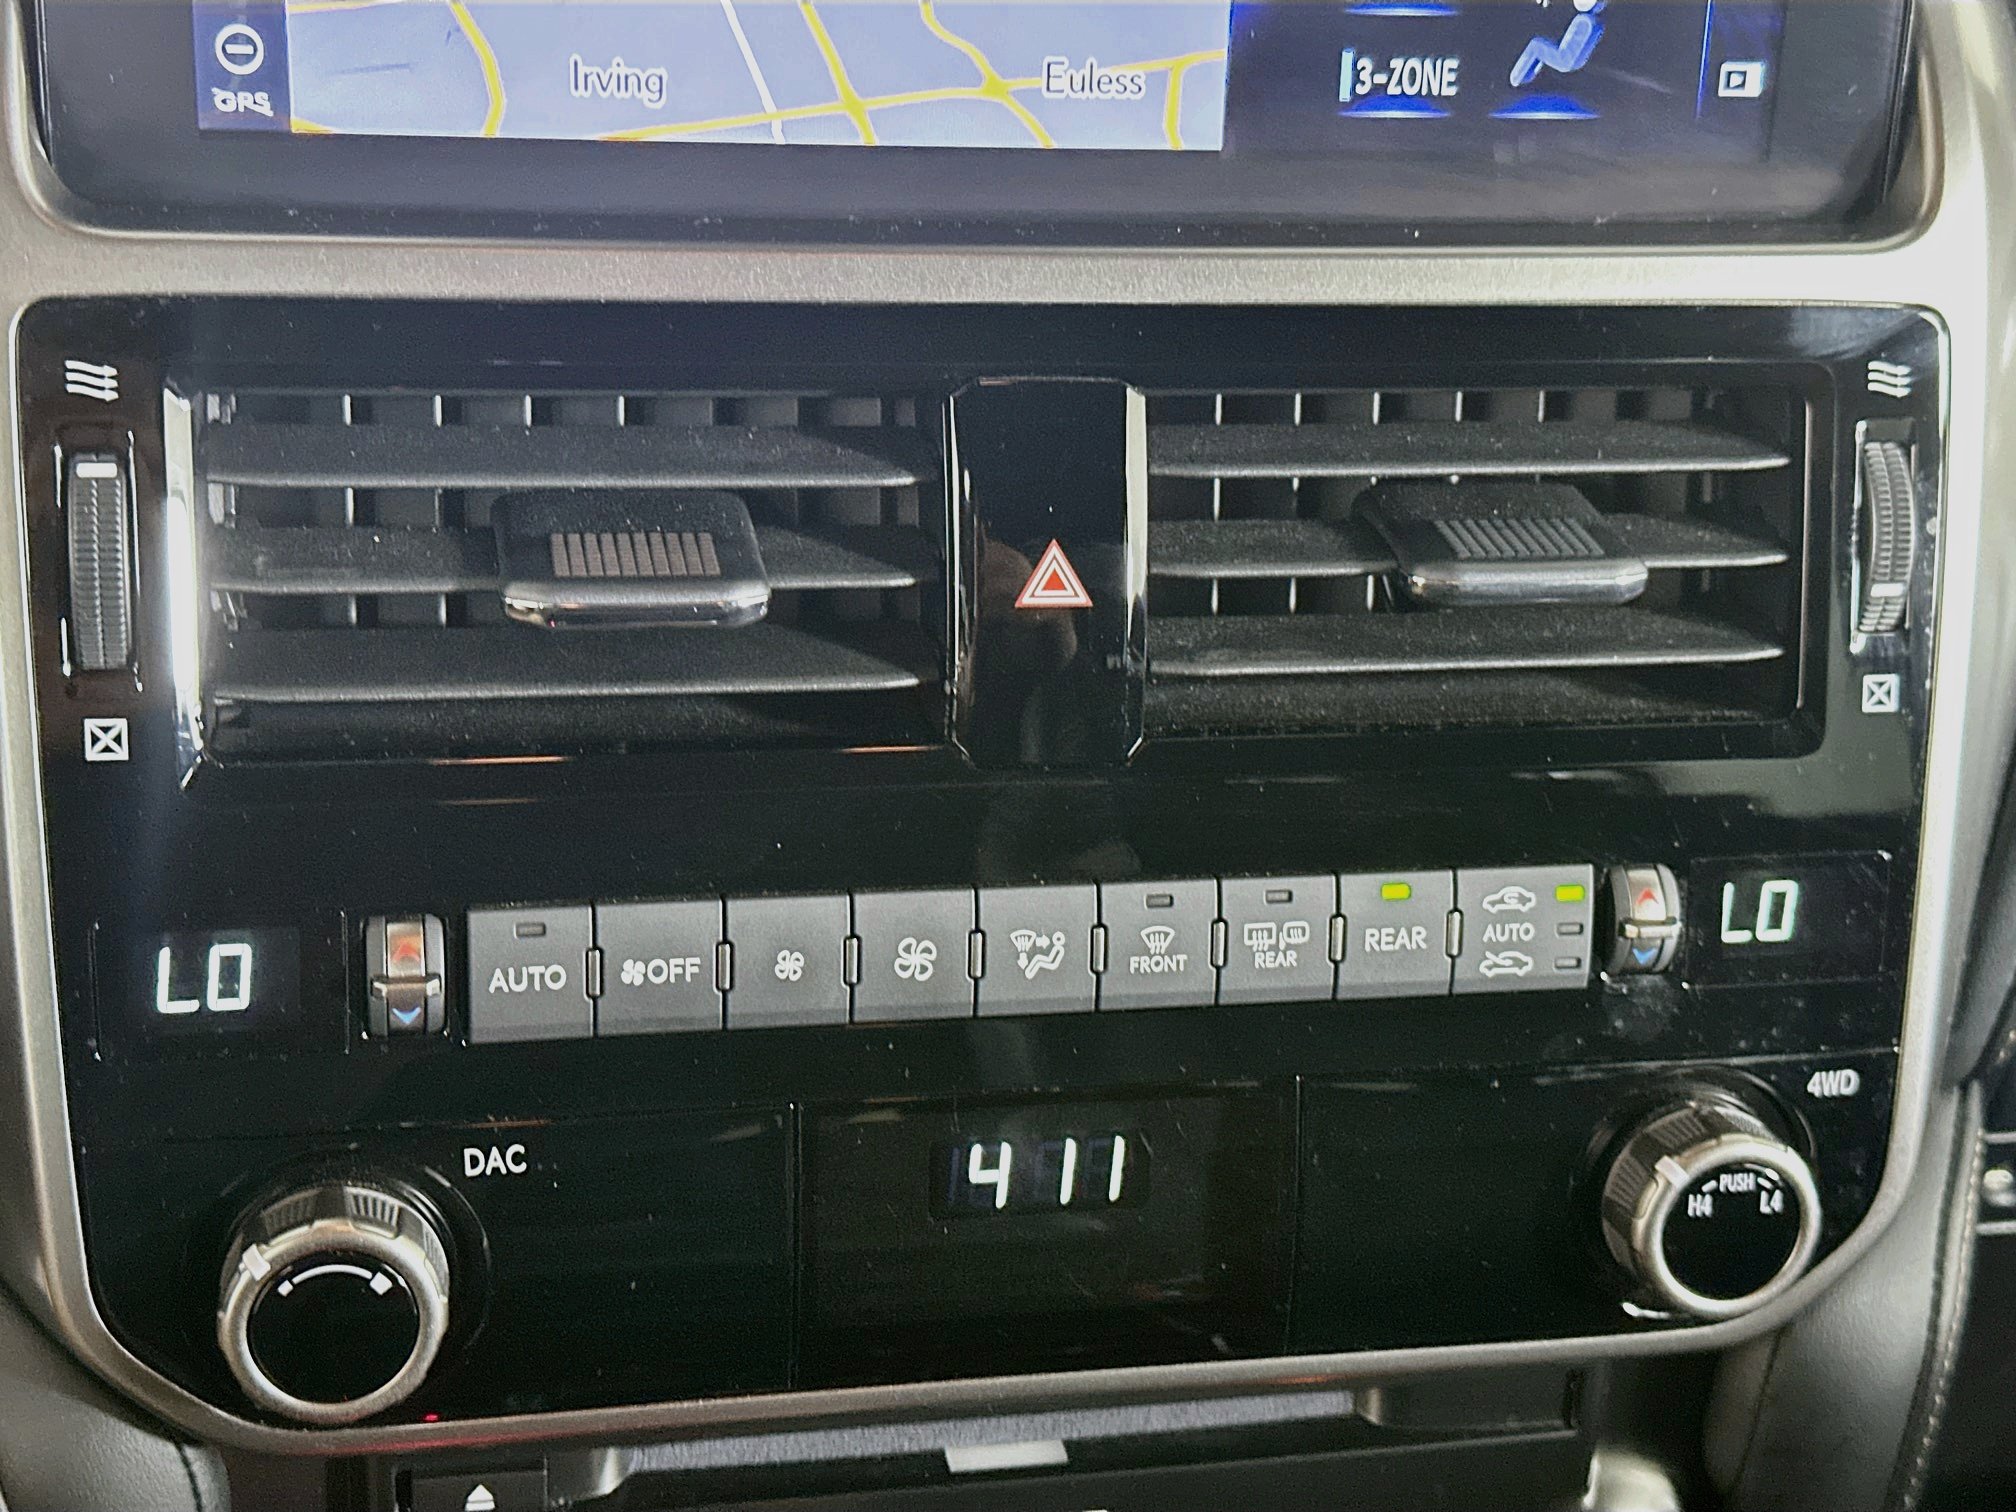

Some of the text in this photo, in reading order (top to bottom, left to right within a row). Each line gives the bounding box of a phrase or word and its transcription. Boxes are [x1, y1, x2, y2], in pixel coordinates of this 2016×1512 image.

[571, 56, 666, 106] Irving
[1043, 58, 1147, 99] Euless
[1355, 55, 1460, 97] 3-ZONE
[1364, 926, 1427, 952] REAR
[1482, 923, 1536, 943] AUTO
[647, 957, 701, 984] OFF
[1129, 953, 1188, 975] FRONT
[1254, 950, 1298, 969] REAR
[488, 964, 567, 994] AUTO
[1806, 1068, 1861, 1098] 4WD
[463, 1144, 528, 1177] DAC
[1719, 1173, 1756, 1193] PUSH
[1687, 1193, 1714, 1218] H4
[1759, 1191, 1785, 1214] L4
